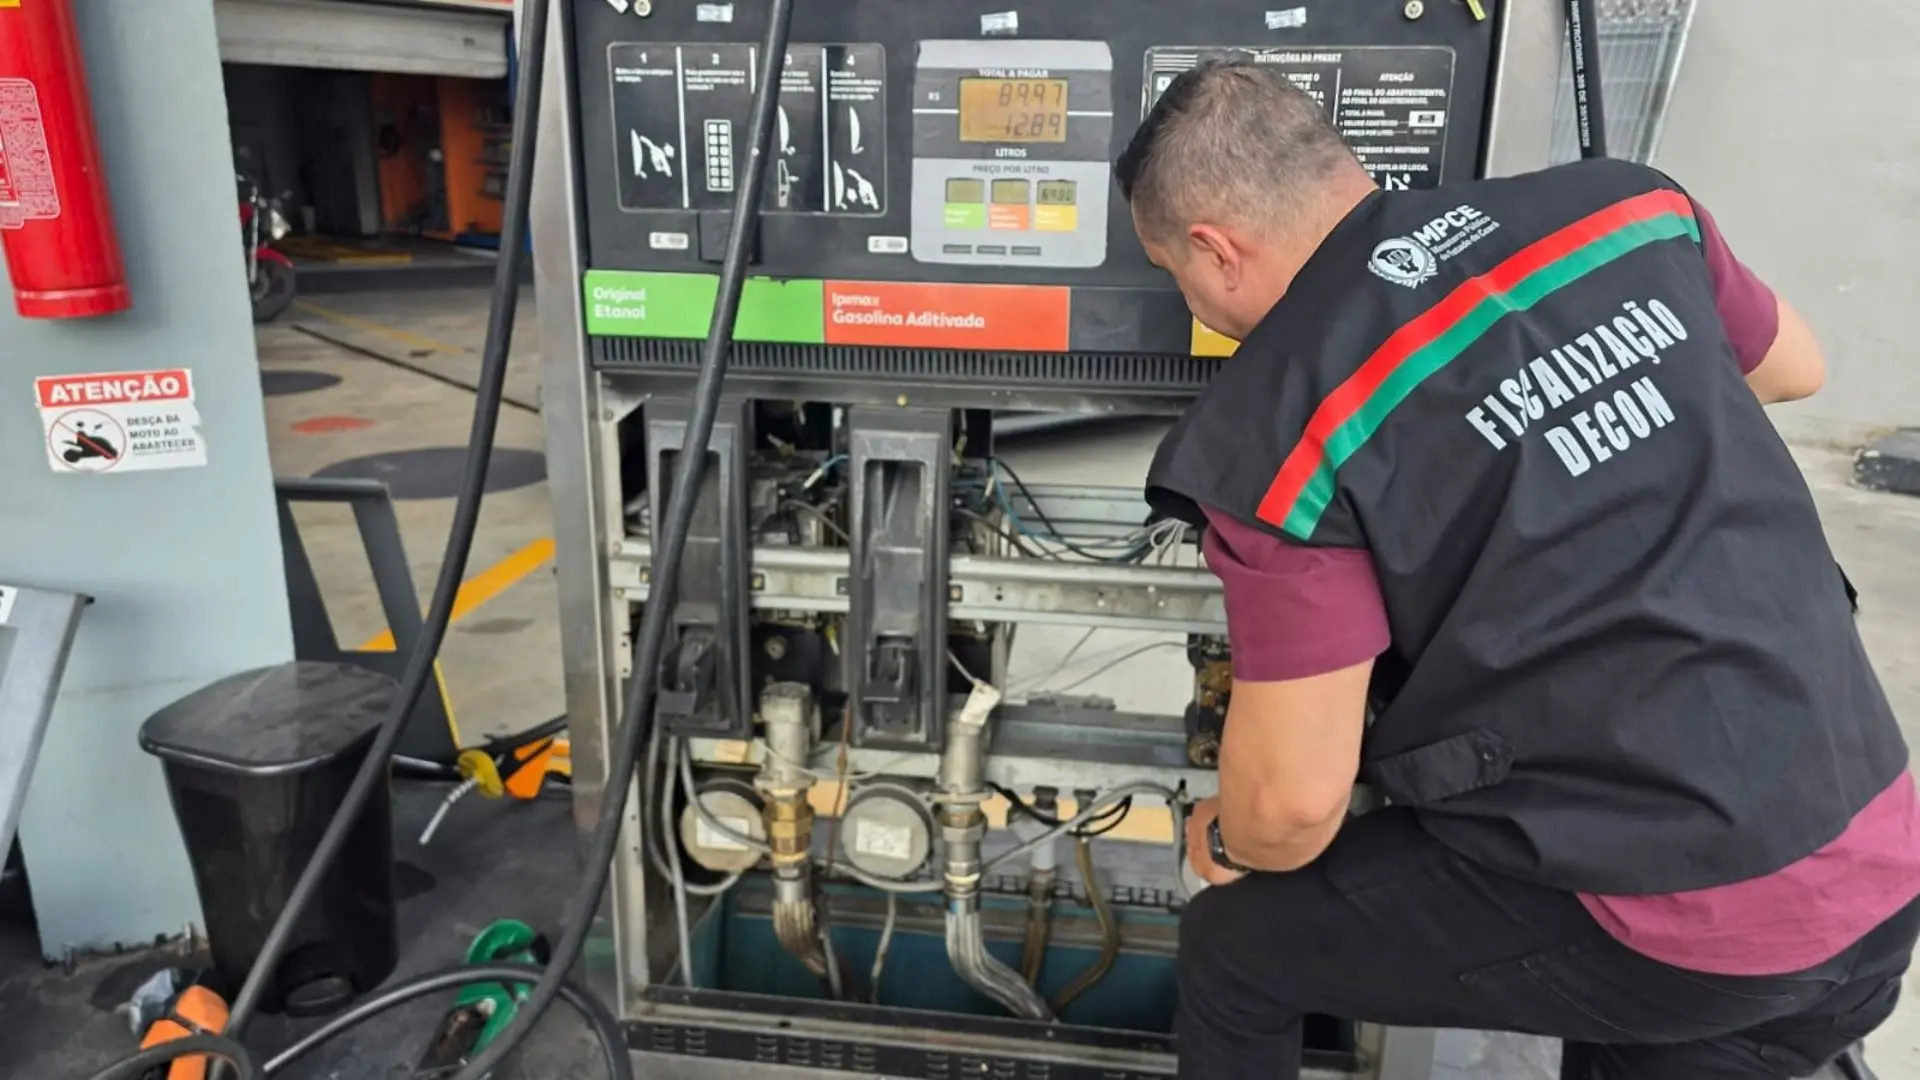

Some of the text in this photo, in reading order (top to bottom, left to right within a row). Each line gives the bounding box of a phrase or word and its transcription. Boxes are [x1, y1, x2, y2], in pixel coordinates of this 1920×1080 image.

[640, 51, 648, 64] 1
[711, 52, 720, 65] 2
[846, 53, 855, 67] 4
[978, 68, 1049, 78] TOTAL A PAGAR
[1379, 71, 1415, 83] ATENÇÃO
[1577, 89, 1587, 104] DE
[995, 147, 1027, 158] LITROS
[972, 163, 1050, 175] PREÇO POR LITRO
[1412, 204, 1483, 247] MPCE
[593, 286, 647, 305] Original
[594, 303, 647, 319] Etanol
[831, 309, 985, 329] Gasolina Aditivada
[1465, 298, 1688, 451] FISCALIZAÇÃO
[50, 374, 181, 404] ATENÇÃO
[126, 414, 182, 427] DESÇA DA
[1544, 376, 1676, 477] DECON
[129, 428, 179, 440] MOTO AO
[132, 438, 196, 452] ABASTECER
